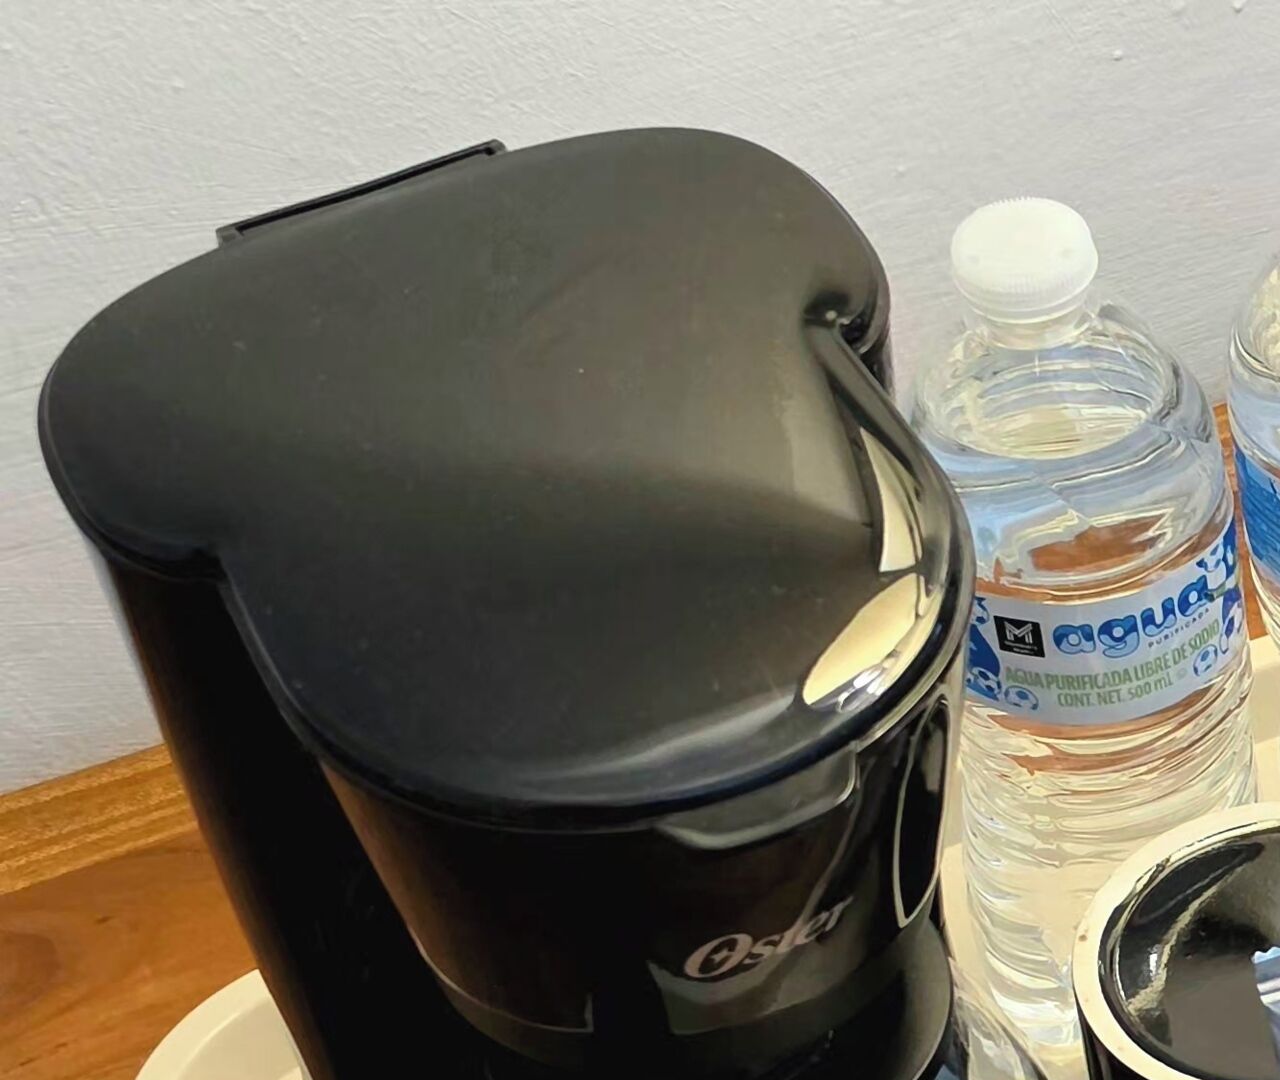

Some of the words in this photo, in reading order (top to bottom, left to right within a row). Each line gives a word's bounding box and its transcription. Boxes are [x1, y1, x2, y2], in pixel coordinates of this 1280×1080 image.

[1053, 574, 1209, 657] agua
[1005, 666, 1044, 689] AGUA
[1048, 667, 1132, 691] PURIFICADA
[1134, 652, 1171, 684] LIBRE
[1172, 643, 1188, 665] DE
[1189, 618, 1220, 656] SODIO
[1057, 692, 1092, 707] CONT.
[1099, 690, 1123, 706] NET.
[1128, 683, 1152, 700] 500
[684, 896, 854, 978] Oster
